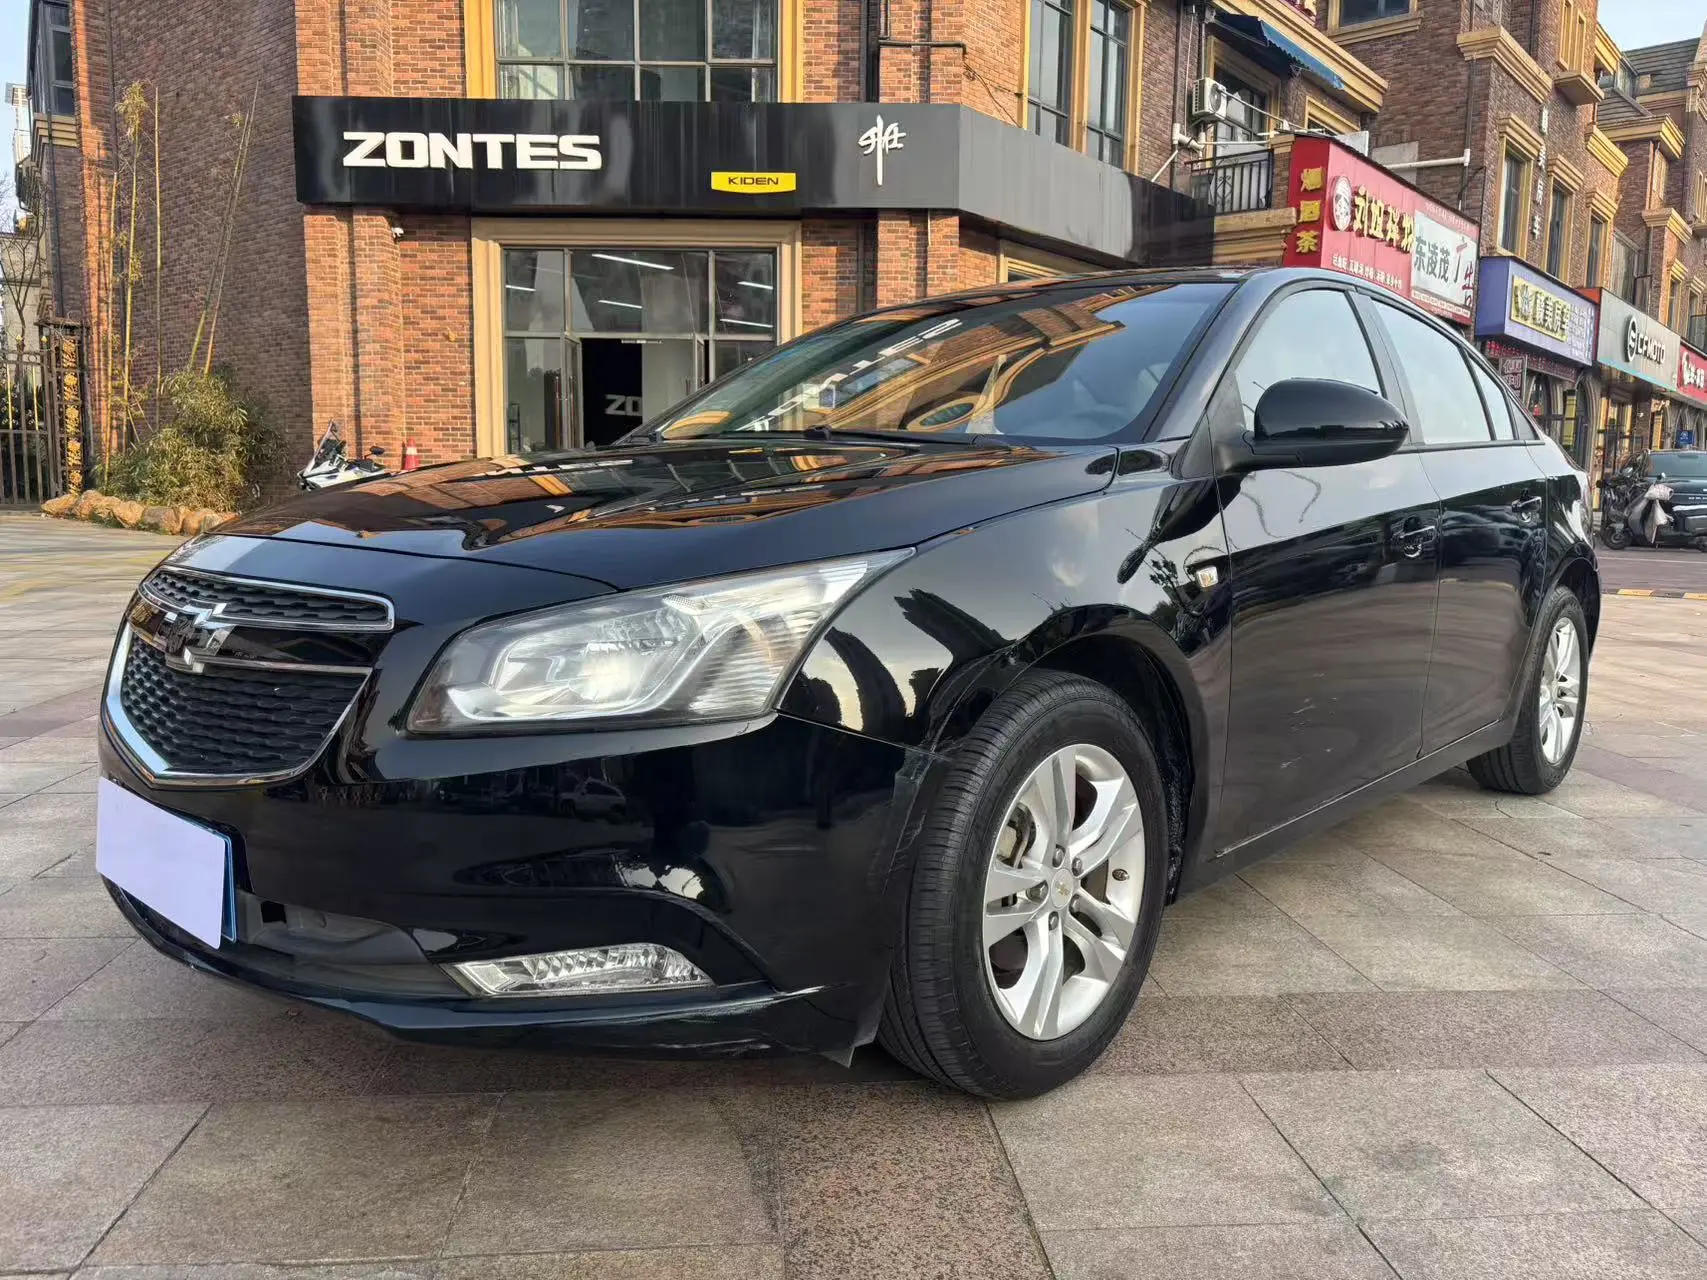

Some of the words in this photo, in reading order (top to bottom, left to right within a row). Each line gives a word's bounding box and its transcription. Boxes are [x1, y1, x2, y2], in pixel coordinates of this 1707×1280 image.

[343, 131, 602, 170] ZONTES
[728, 177, 779, 185] KIDEN
[1638, 333, 1665, 364] CFMOTO
